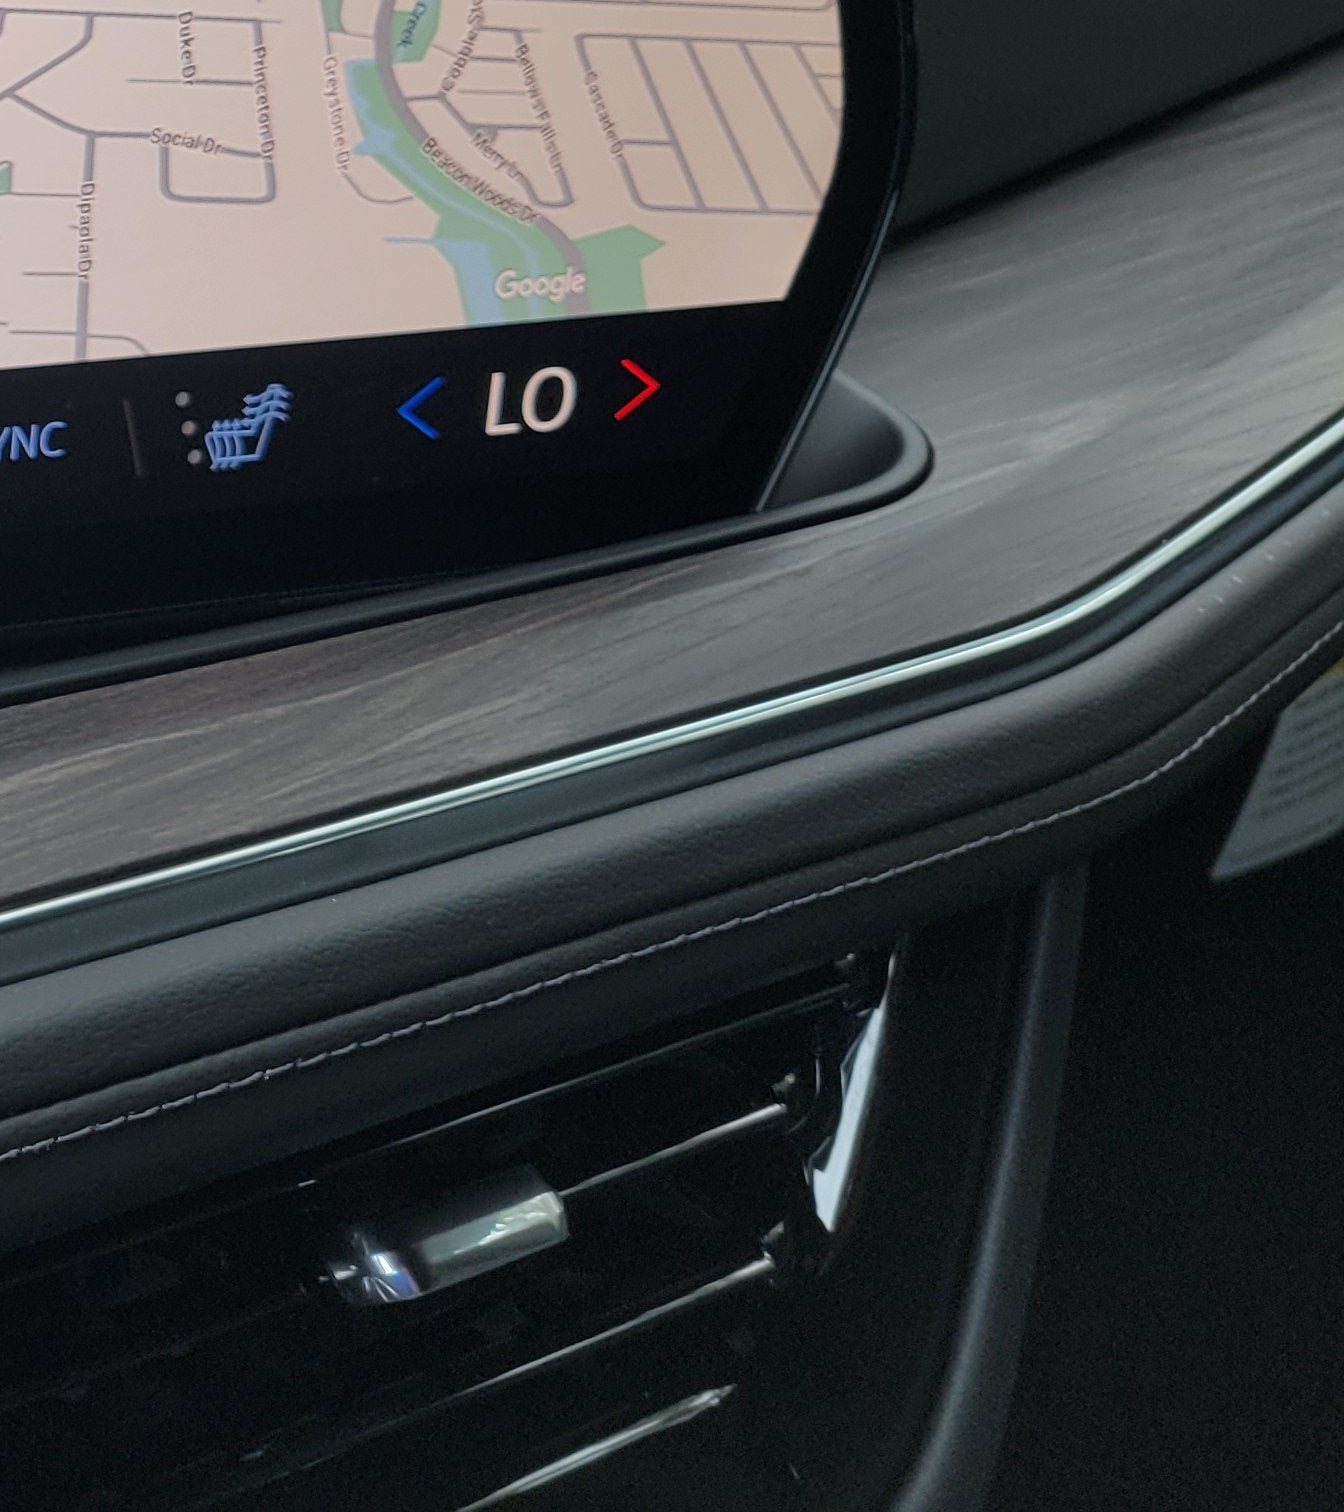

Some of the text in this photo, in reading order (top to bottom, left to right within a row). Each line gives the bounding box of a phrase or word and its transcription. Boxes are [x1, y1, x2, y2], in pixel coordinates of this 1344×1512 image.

[178, 11, 195, 85] Duke Dr
[254, 46, 275, 160] Princeton Dr
[322, 57, 349, 171] Greystone Dr
[150, 127, 221, 154] Social Dr
[76, 182, 94, 280] Dipaola Dr
[494, 268, 585, 301] Google
[485, 367, 577, 437] LO
